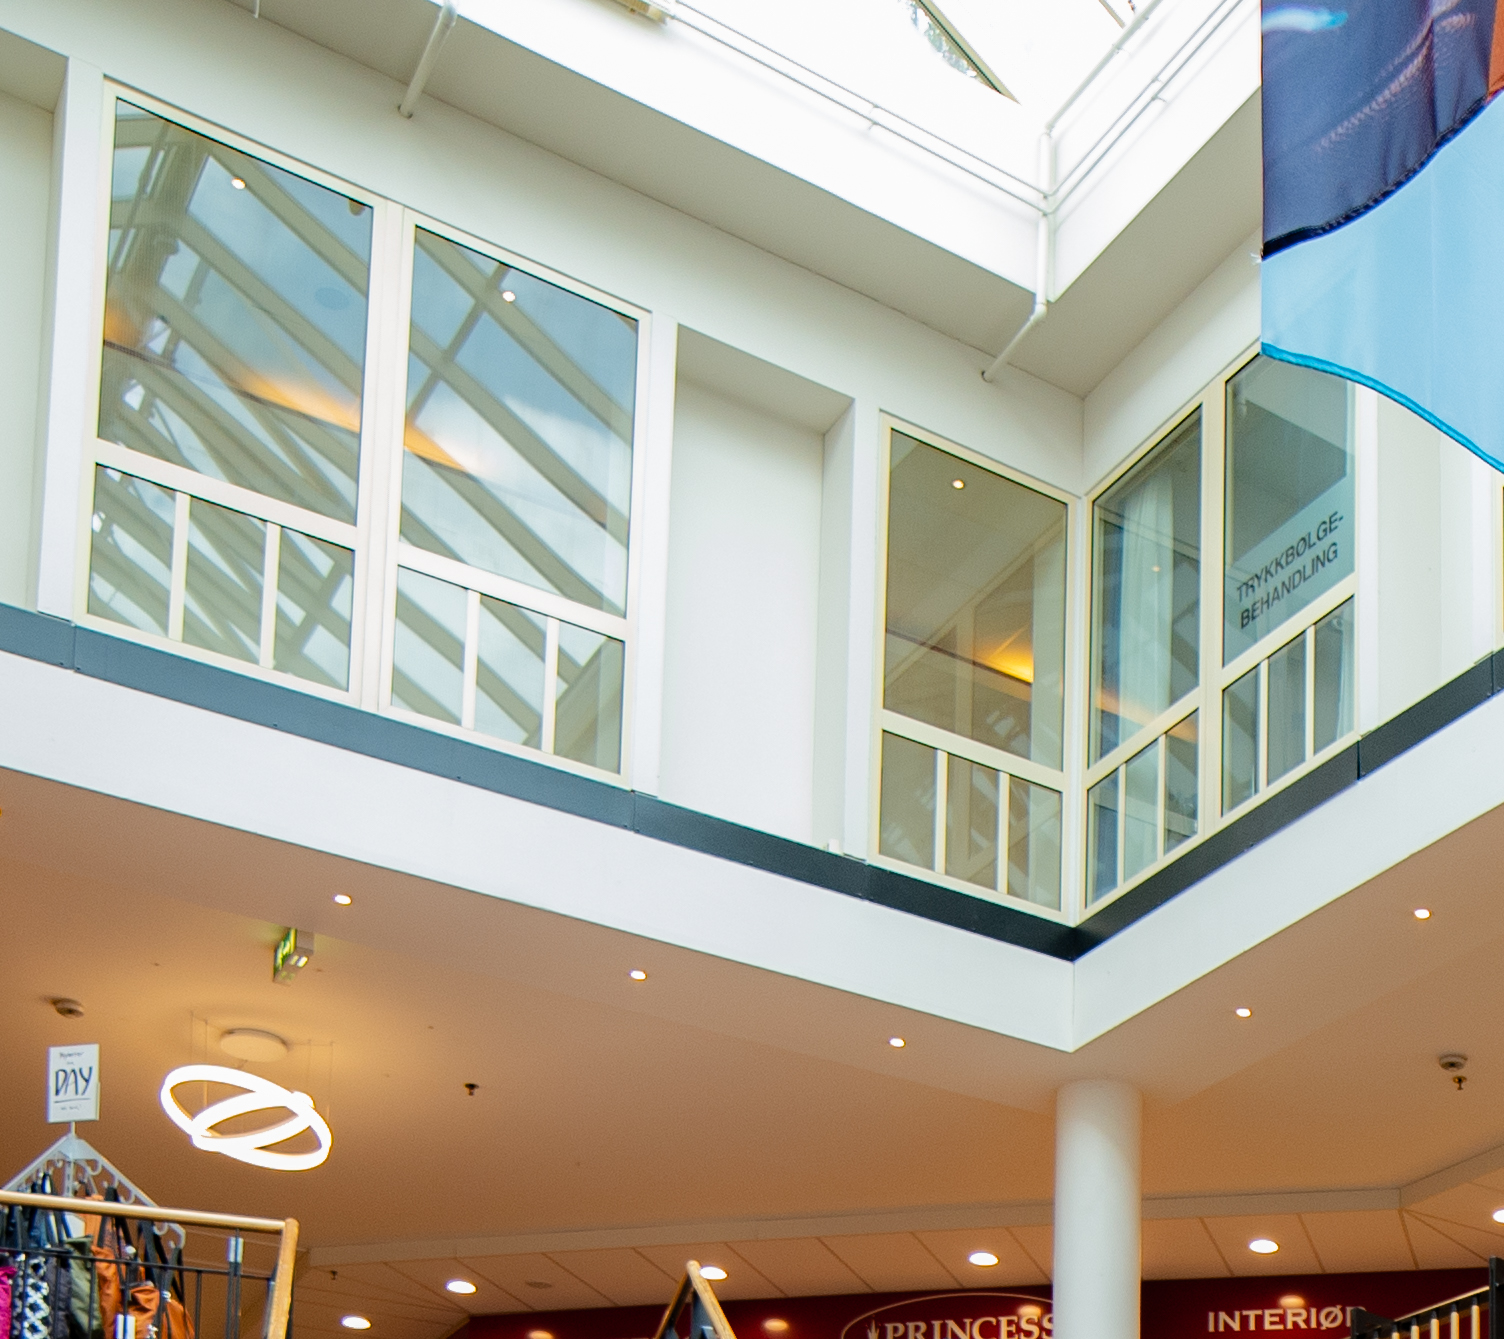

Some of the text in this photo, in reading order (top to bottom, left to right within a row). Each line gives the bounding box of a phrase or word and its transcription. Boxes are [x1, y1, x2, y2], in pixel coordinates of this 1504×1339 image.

[1236, 511, 1344, 603] TRYKKBØLGE-
[1240, 541, 1338, 630] BEHANDLING
[54, 1065, 94, 1097] DAY
